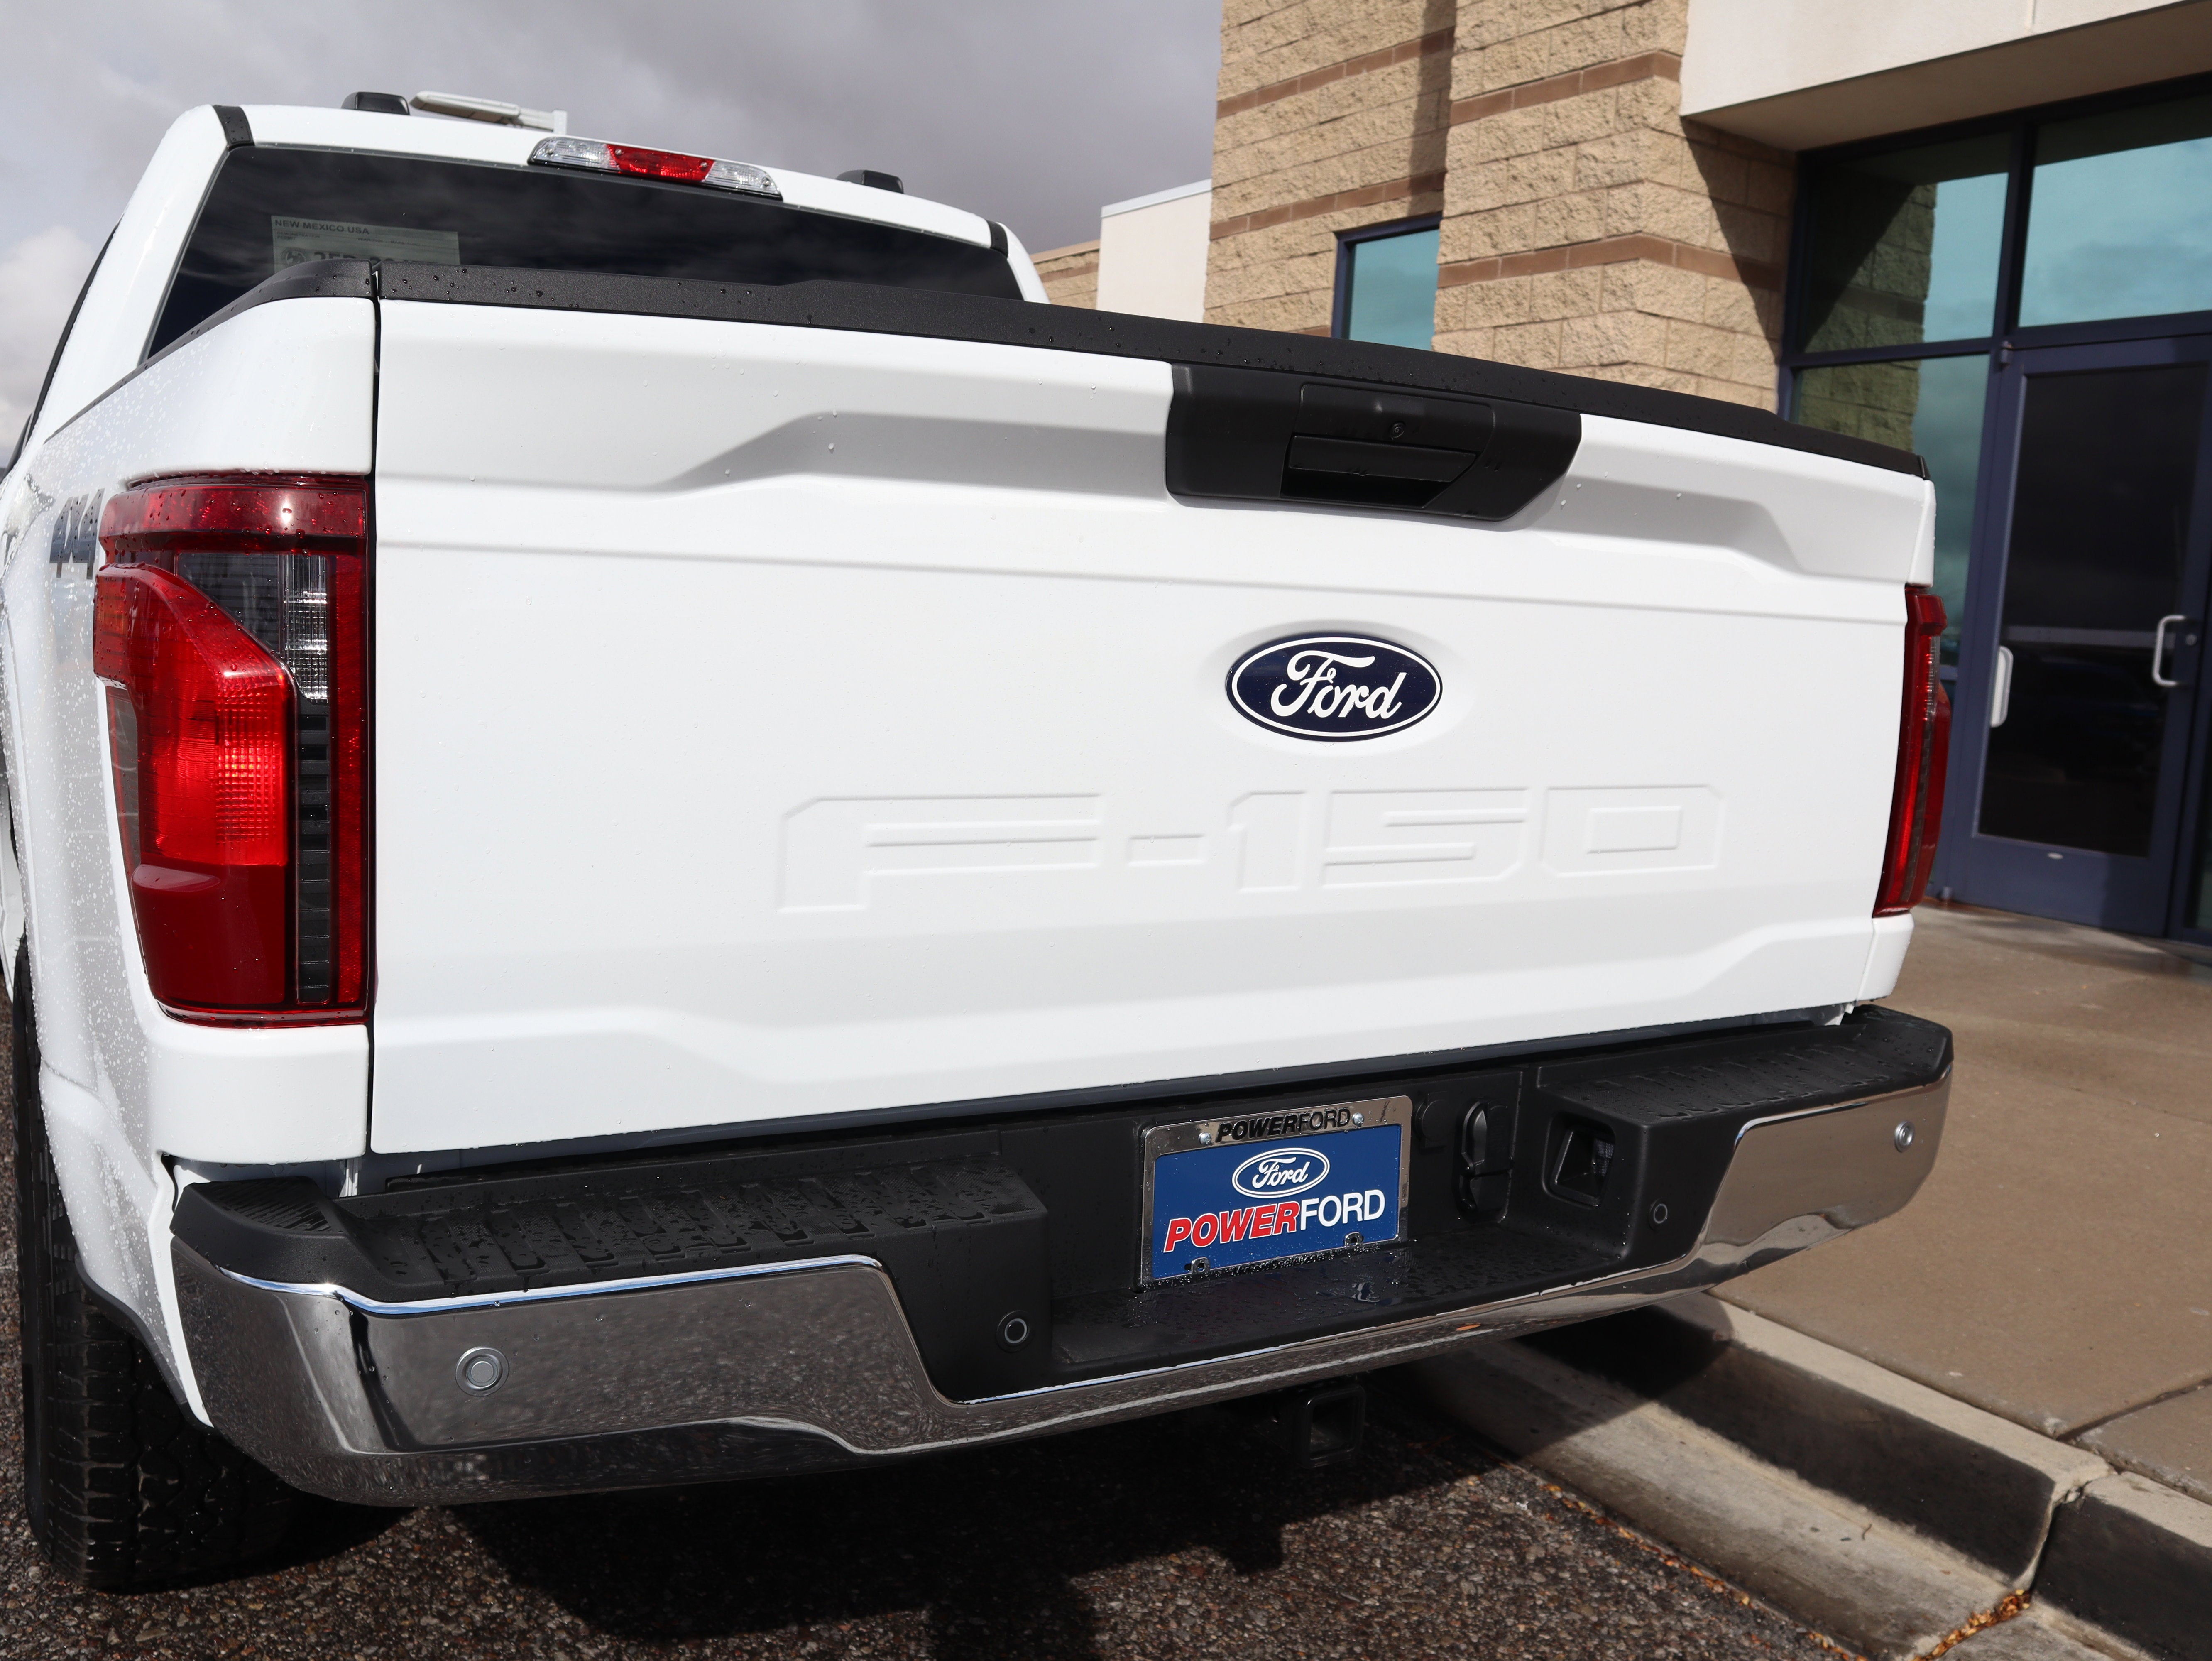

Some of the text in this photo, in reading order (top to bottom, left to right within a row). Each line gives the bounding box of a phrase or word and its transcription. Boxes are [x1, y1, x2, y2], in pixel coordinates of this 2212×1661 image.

[275, 219, 370, 235] NEW MEXICO USA
[1271, 650, 1407, 719] Ford
[777, 784, 1724, 913] F-150
[1215, 1107, 1351, 1143] POWERFORD
[1252, 1157, 1310, 1188] Ford
[1163, 1189, 1385, 1253] POWERFORD
